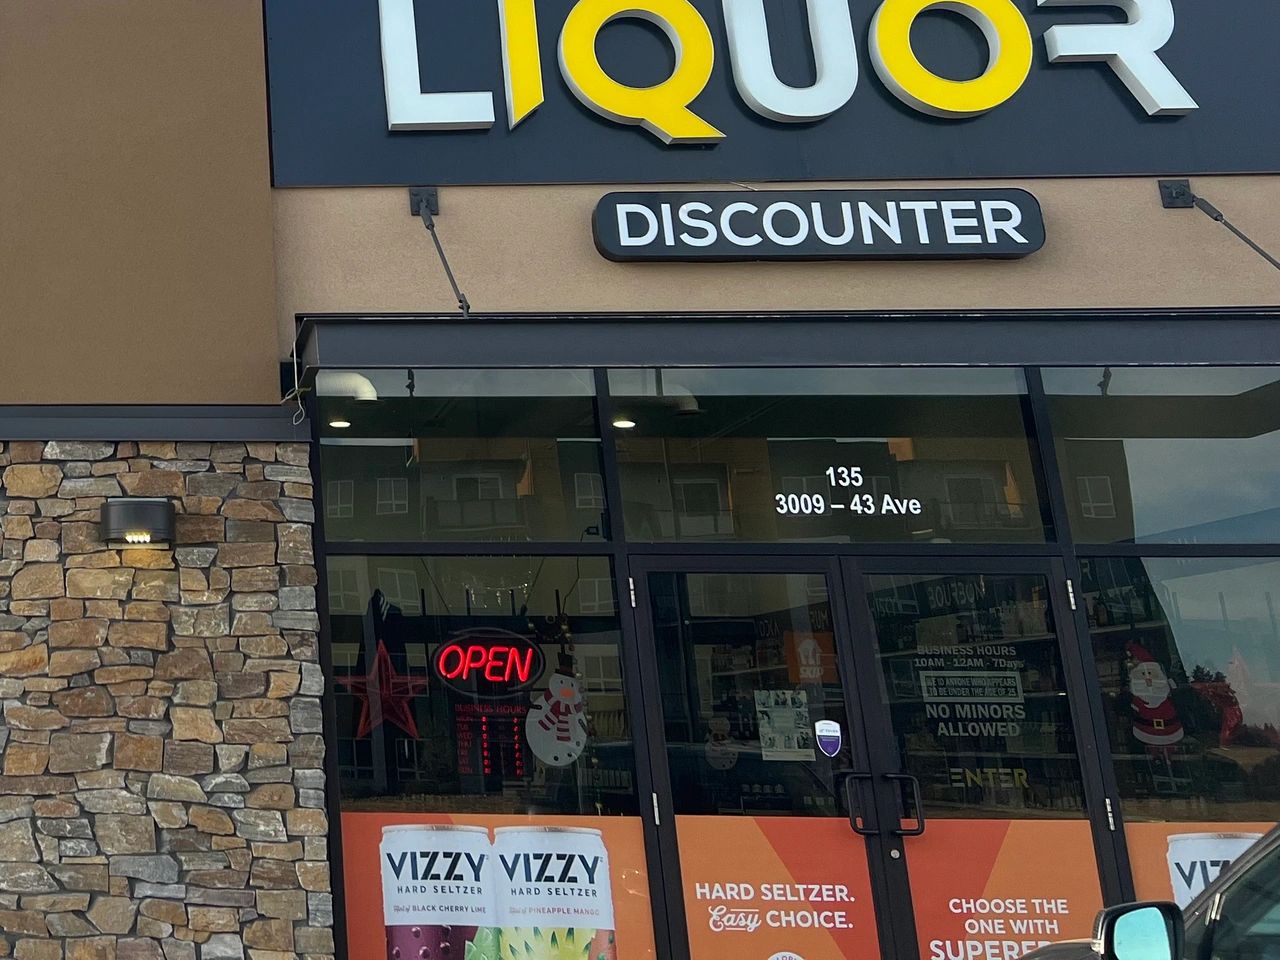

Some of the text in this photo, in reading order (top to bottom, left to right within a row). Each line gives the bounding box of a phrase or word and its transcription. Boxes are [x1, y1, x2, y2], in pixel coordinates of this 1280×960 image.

[616, 200, 1028, 247] DISCOUNTER
[825, 466, 863, 487] 135
[775, 493, 825, 515] 3009
[850, 493, 875, 515] 43
[881, 493, 922, 515] Ave
[917, 645, 1017, 656] BUSINESS HOURS
[438, 643, 534, 683] OPEN
[914, 658, 945, 667] 10AM
[953, 658, 984, 668] 12AM
[925, 704, 1026, 719] NO MINORS
[937, 722, 1020, 737] ALLOWED
[950, 767, 1030, 789] ENTER
[386, 851, 486, 882] VIZZY
[498, 853, 600, 885] VIZZY
[1174, 860, 1231, 890] VIZ
[397, 885, 483, 895] HARD SELTZER
[511, 887, 598, 898] HARD SELTZER
[695, 883, 856, 902] HARD SELTZER.
[412, 904, 437, 913] BLACK
[439, 905, 469, 913] CHERRY
[471, 905, 487, 914] LIME
[528, 906, 572, 915] PINEAPPLE
[573, 907, 600, 916] MANGO
[948, 898, 1069, 914] CHOOSE THE
[708, 905, 854, 933] Easy CHOICE.
[964, 919, 1059, 934] ONE WITH
